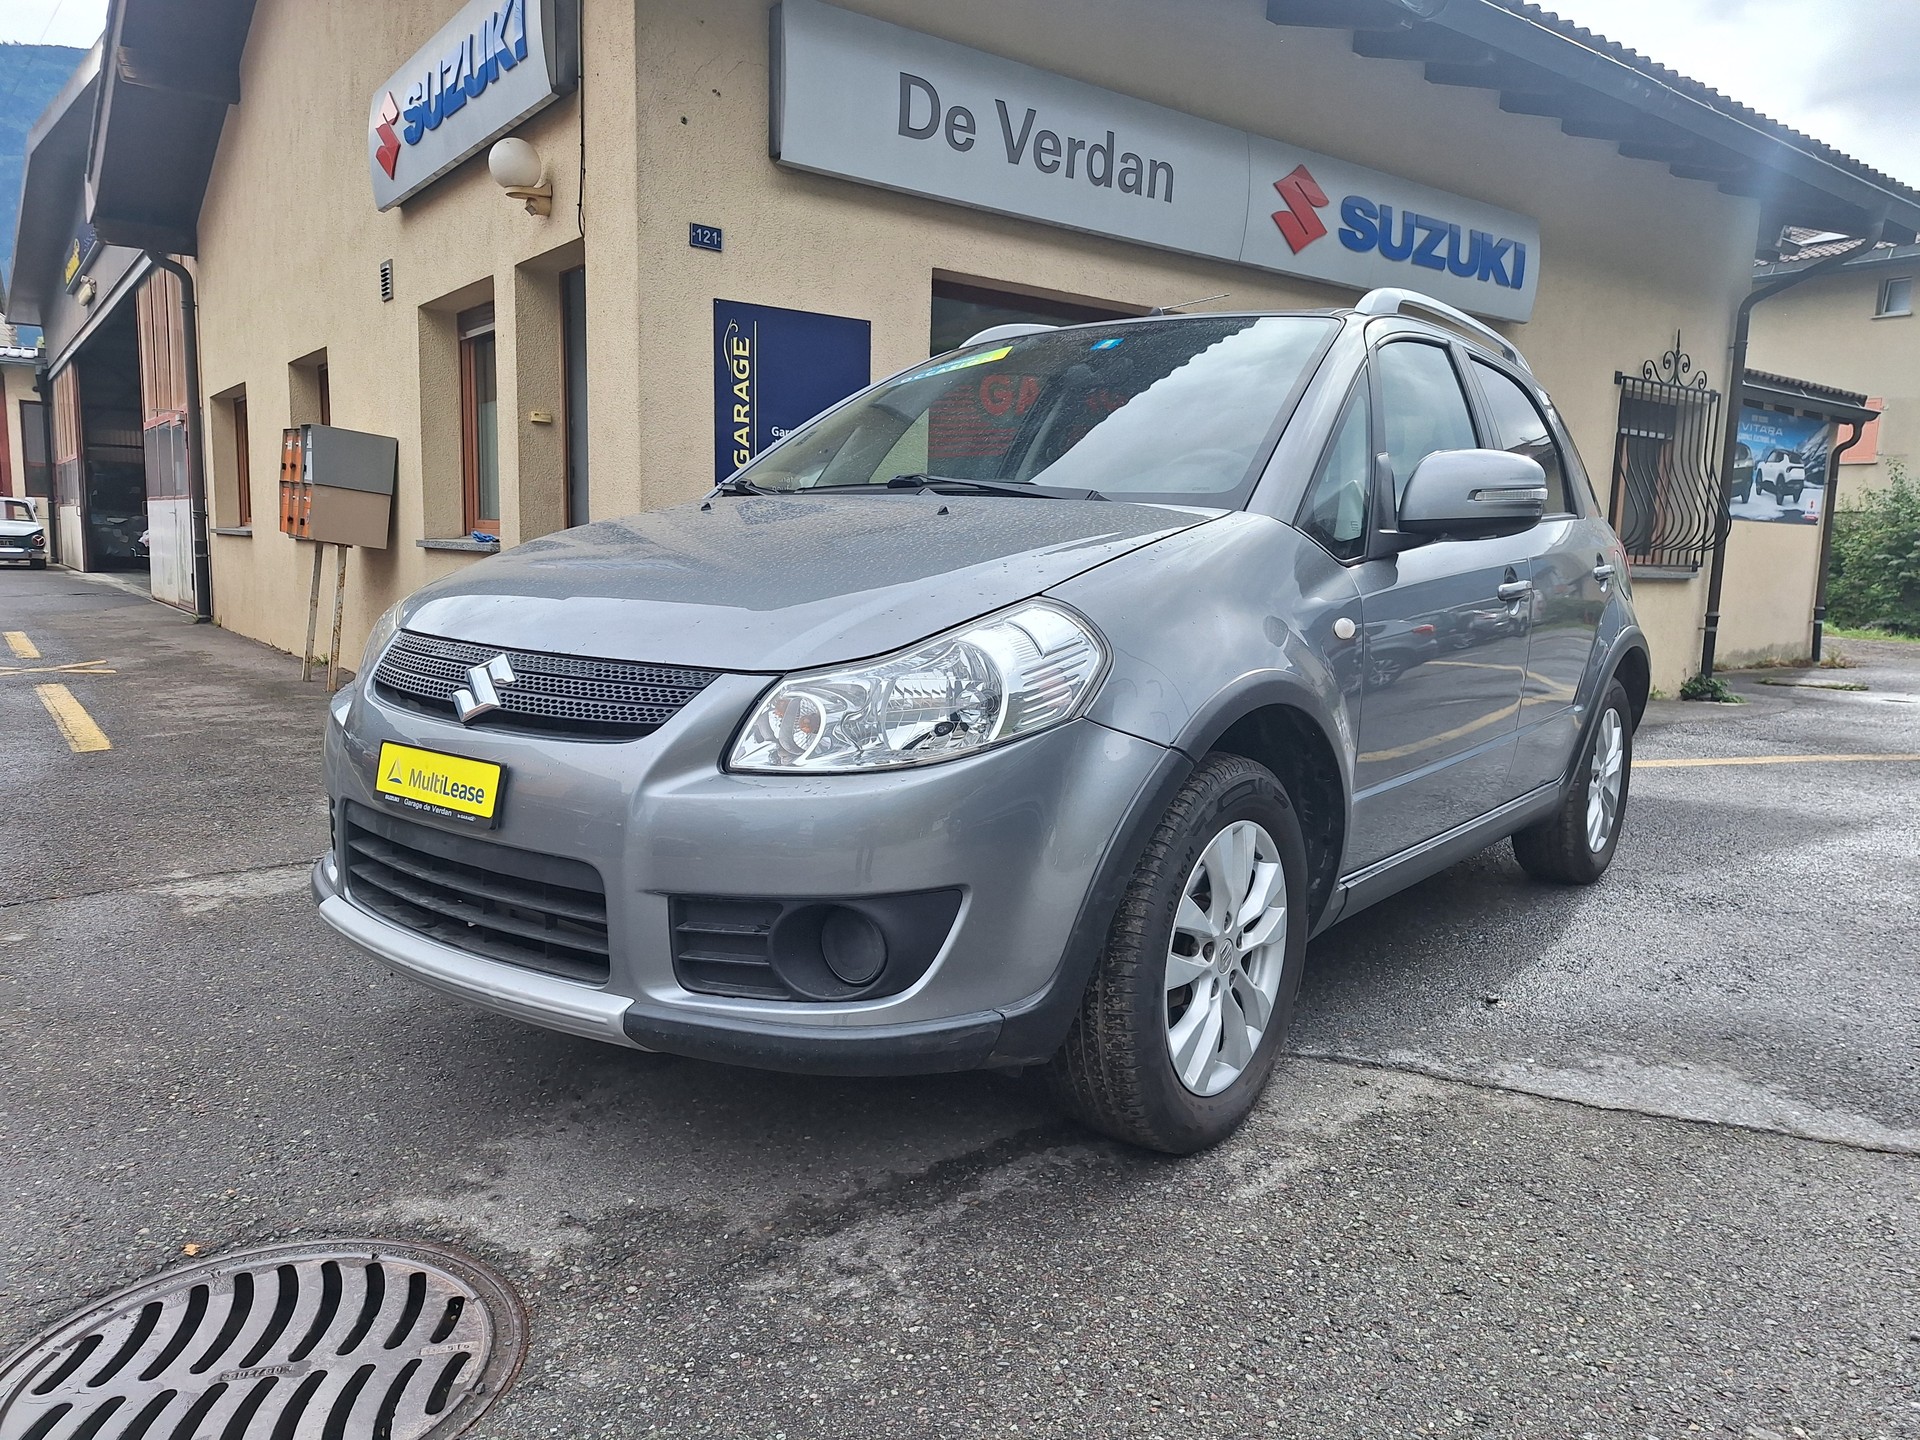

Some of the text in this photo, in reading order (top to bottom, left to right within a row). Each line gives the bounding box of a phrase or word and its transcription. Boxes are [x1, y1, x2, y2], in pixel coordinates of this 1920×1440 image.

[402, 0, 528, 146] SUZUKI
[898, 71, 1175, 203] De Verdan
[696, 228, 718, 245] 121
[1338, 195, 1526, 290] SUZUKI
[732, 336, 750, 470] GARAGE
[1742, 423, 1783, 436] VITARA
[403, 798, 453, 817] Garage de Verdan
[408, 768, 485, 804] MultiLease
